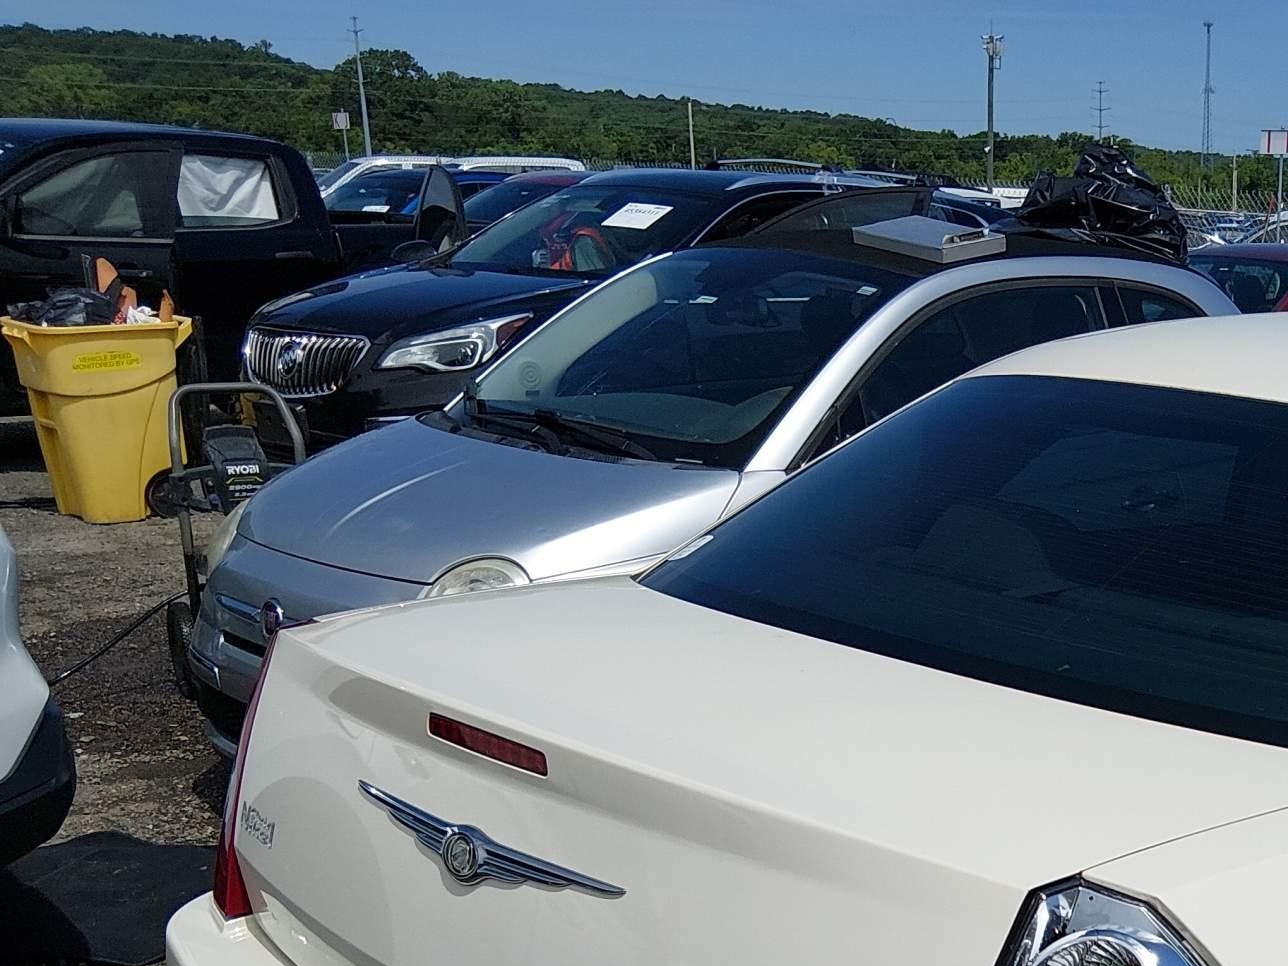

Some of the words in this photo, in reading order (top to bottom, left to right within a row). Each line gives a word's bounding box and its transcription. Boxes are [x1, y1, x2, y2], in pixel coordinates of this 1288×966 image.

[78, 353, 108, 363] VEHICLE
[109, 351, 132, 360] SPEED
[72, 359, 115, 370] MONITORED
[225, 464, 260, 475] RYOBI
